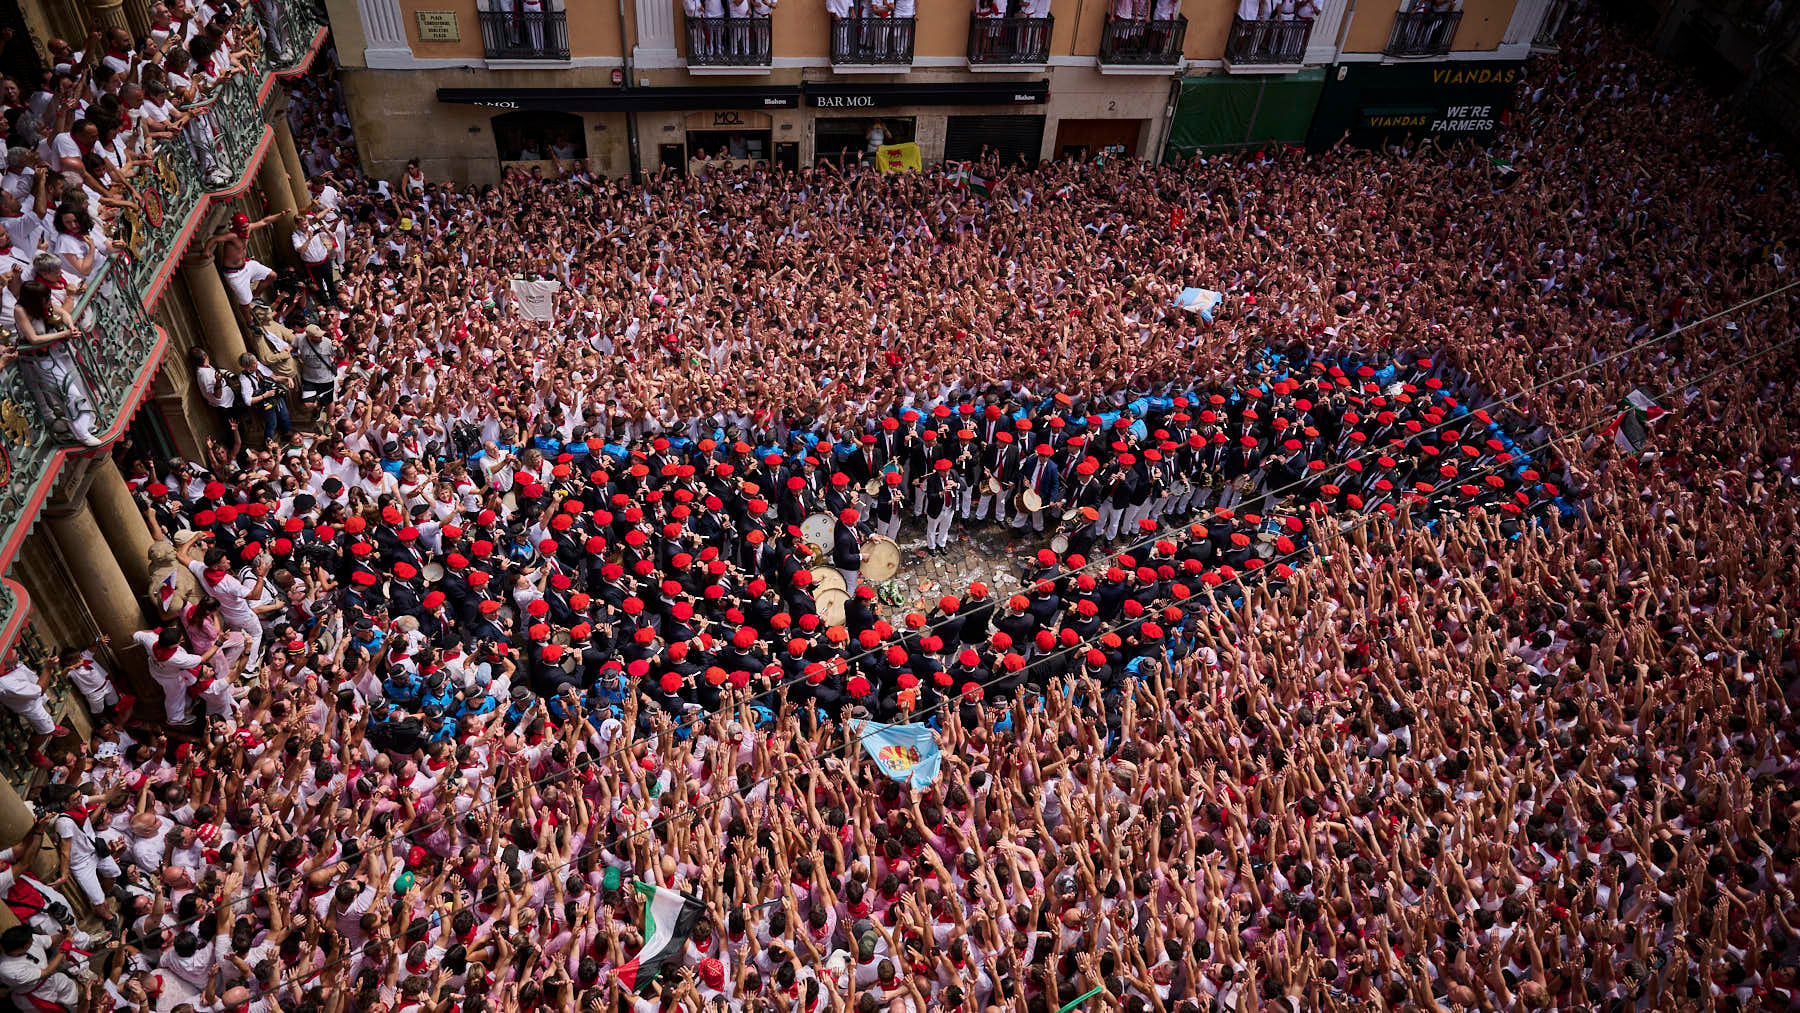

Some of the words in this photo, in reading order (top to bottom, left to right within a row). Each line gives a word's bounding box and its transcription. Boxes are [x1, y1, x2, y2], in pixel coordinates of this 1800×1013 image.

[1433, 69, 1516, 84] VIANDAS
[817, 96, 843, 107] BAR
[846, 96, 875, 107] MOL
[1108, 100, 1117, 112] 2
[1447, 106, 1491, 118] WE'RE
[713, 112, 744, 126] MOL
[1370, 116, 1427, 127] VIANDAS
[1431, 120, 1494, 131] FARMERS
